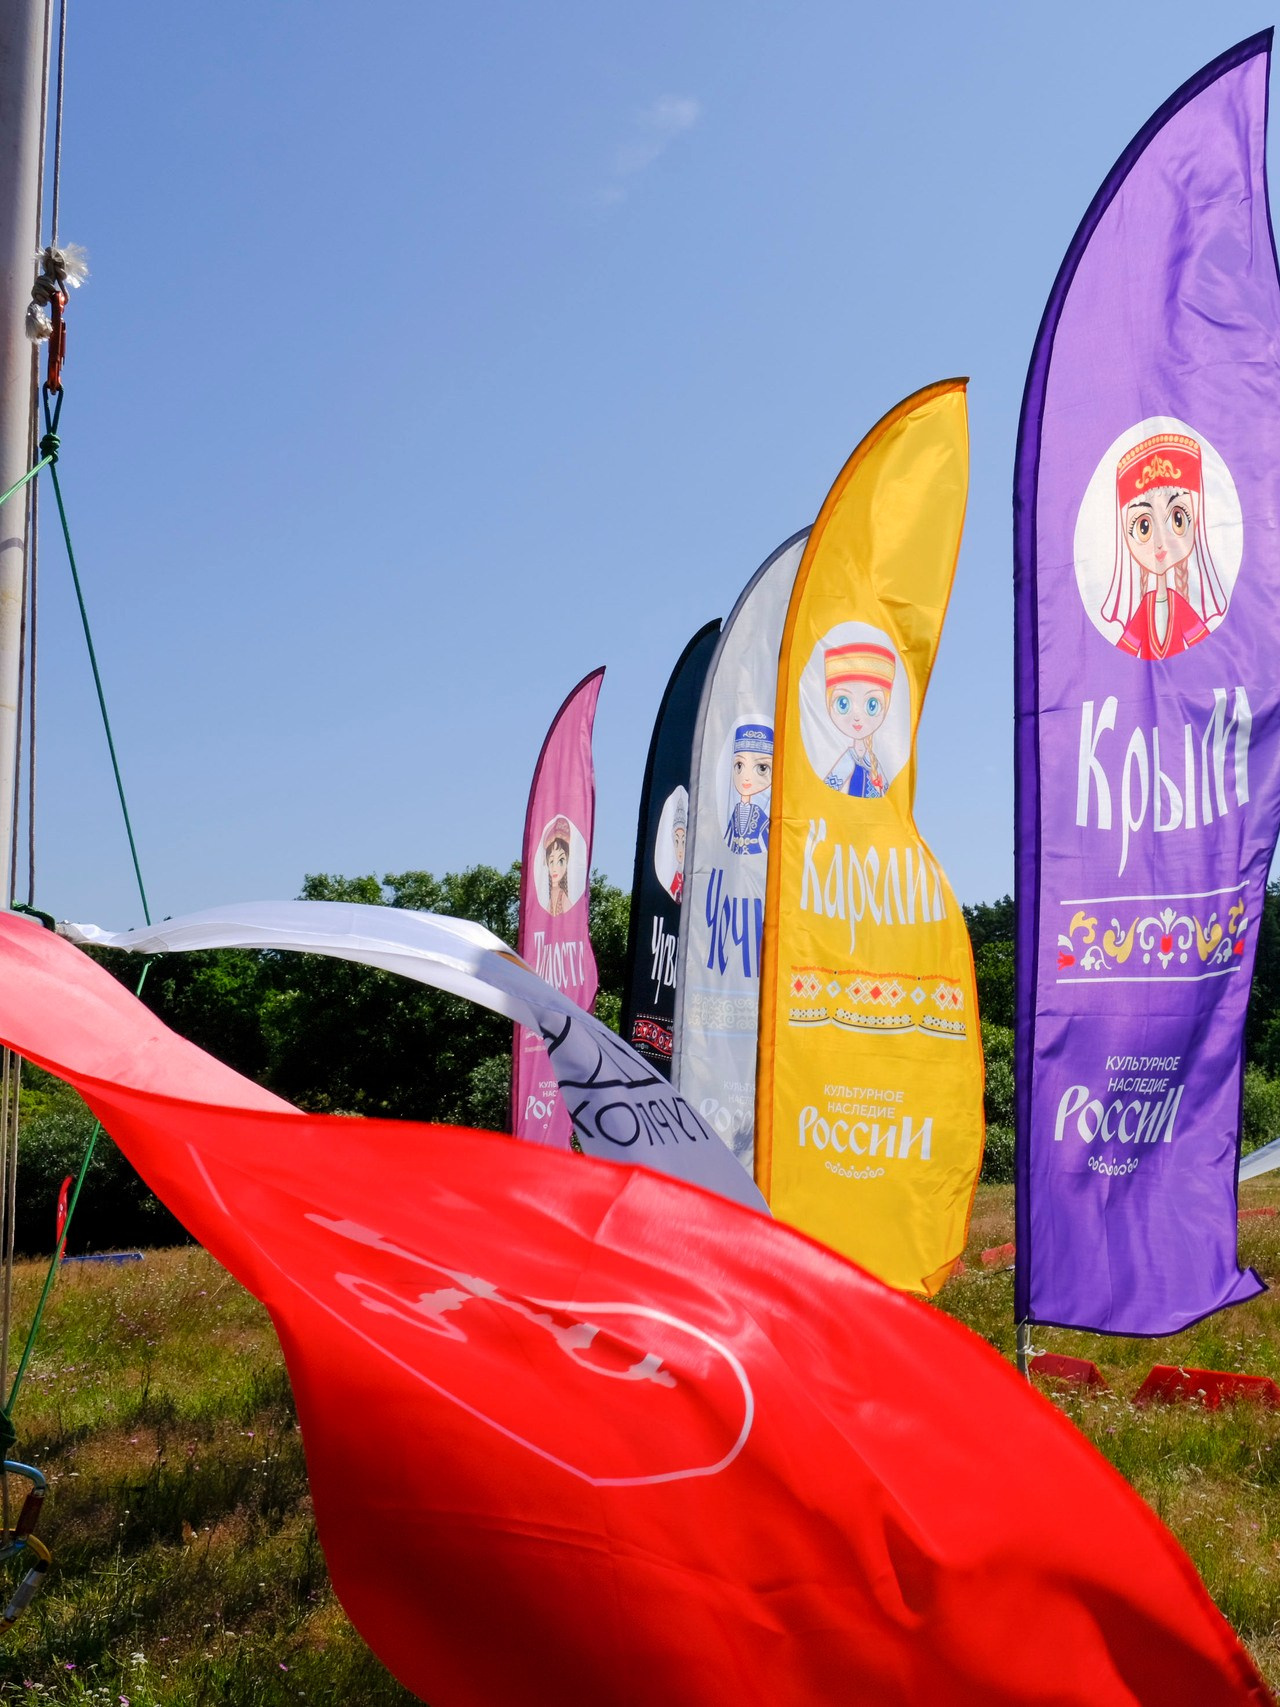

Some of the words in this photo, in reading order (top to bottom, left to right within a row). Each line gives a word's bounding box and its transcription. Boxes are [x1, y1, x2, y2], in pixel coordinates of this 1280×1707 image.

[1105, 1055, 1181, 1071] КУЛЬТУРНОЕ
[824, 1084, 905, 1103] КУЛЬТУРНОЕ
[1107, 1077, 1169, 1095] НАСЛЕДИЕ
[827, 1101, 896, 1119] НАСЛЕДИЕ
